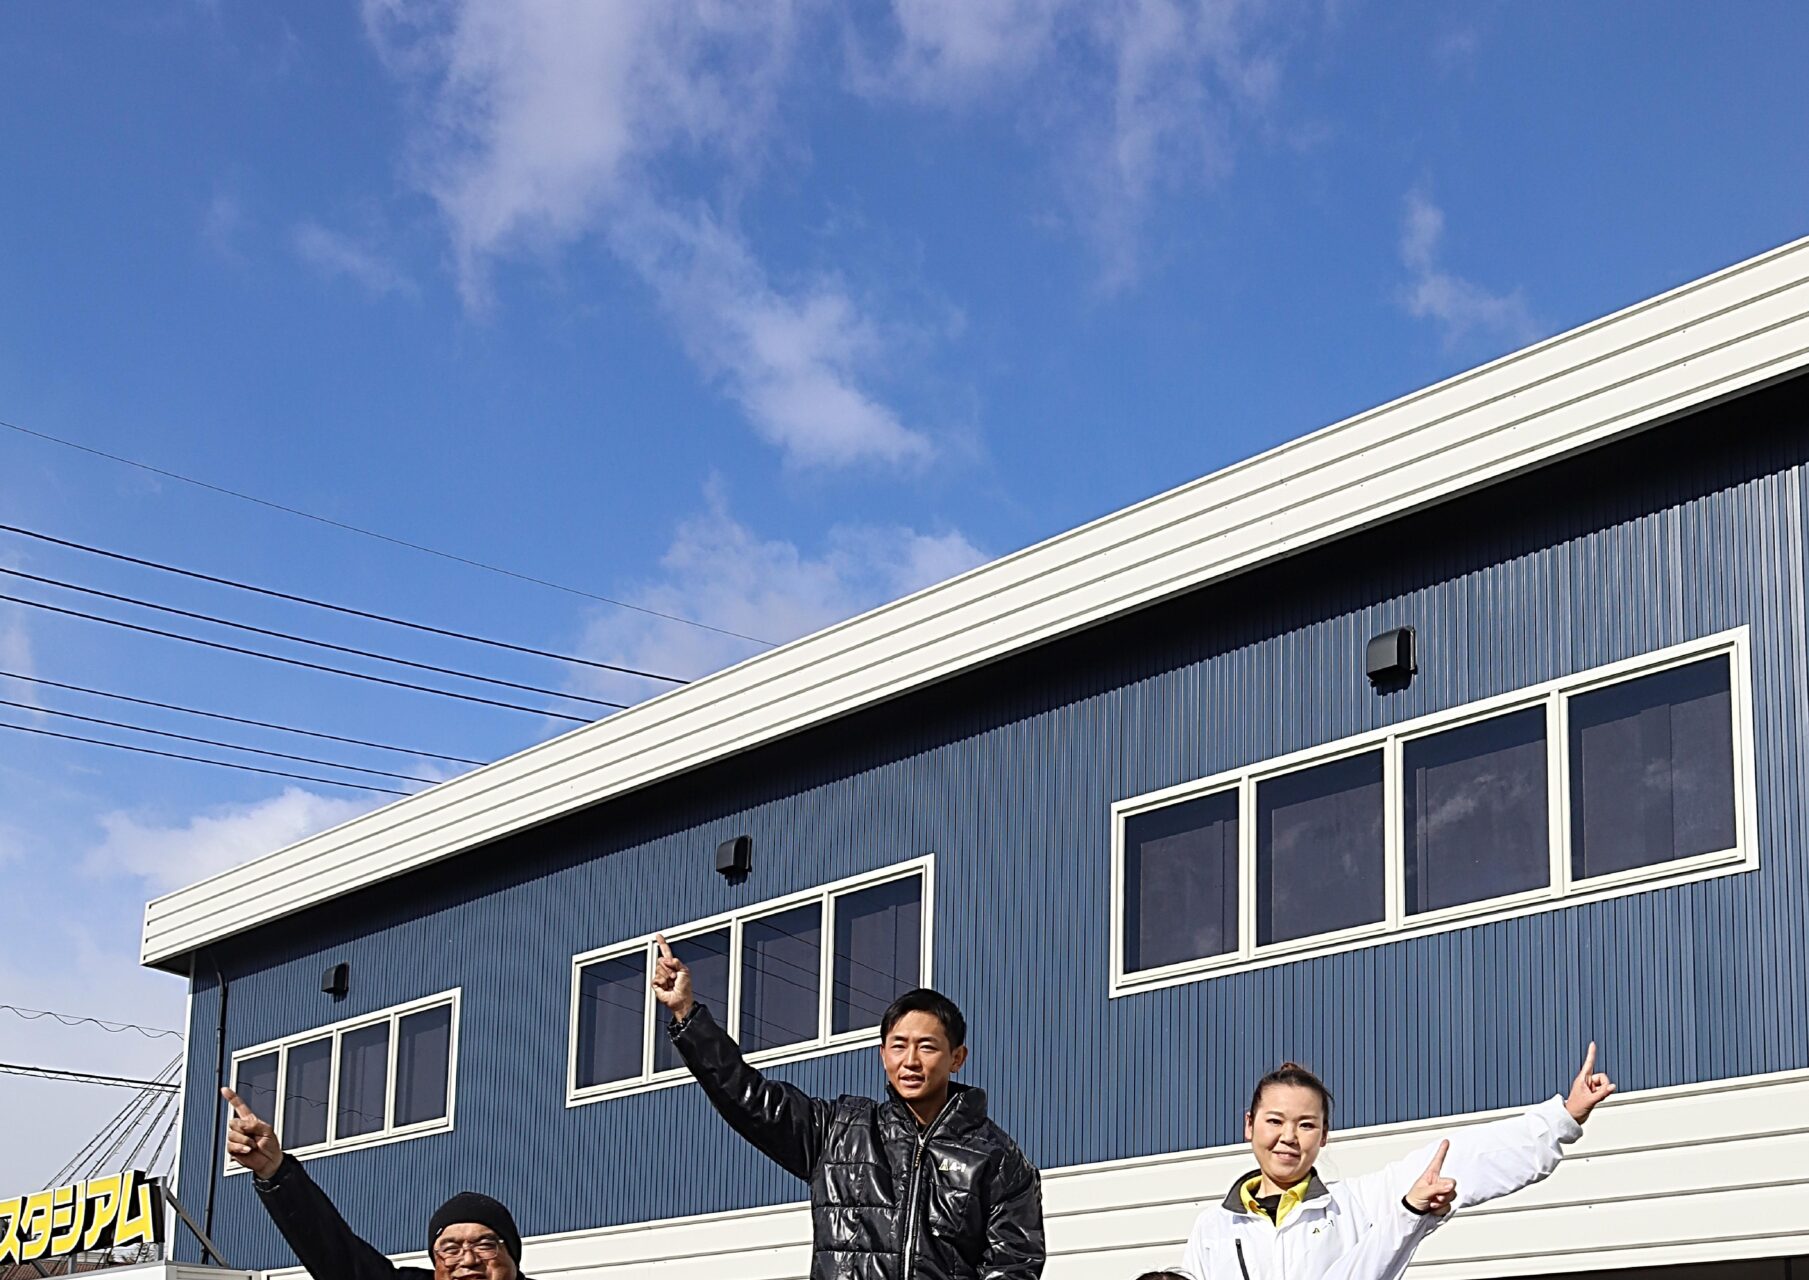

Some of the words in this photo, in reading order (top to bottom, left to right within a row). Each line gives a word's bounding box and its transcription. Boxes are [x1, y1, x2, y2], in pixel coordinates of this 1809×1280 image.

[0, 1169, 154, 1265] スタジアム
